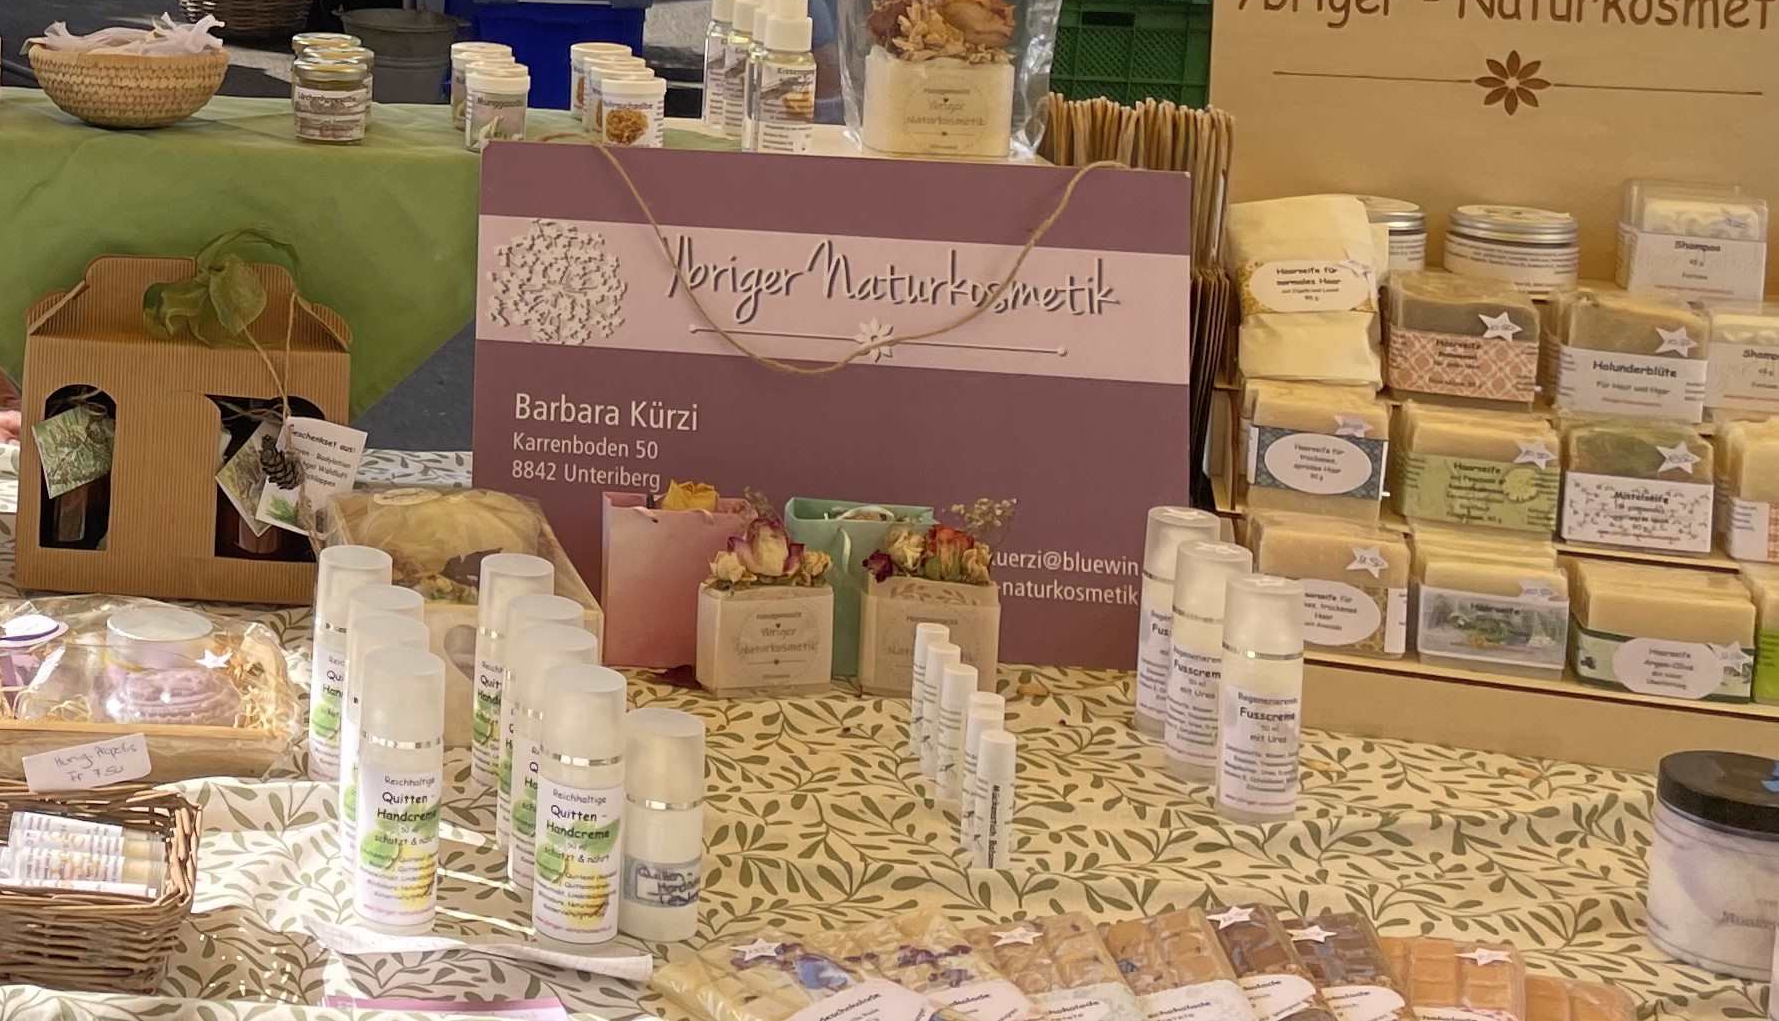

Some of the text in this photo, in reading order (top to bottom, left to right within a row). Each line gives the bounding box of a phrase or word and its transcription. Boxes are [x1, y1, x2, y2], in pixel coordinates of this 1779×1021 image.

[1675, 240, 1721, 252] Shampoo
[661, 234, 1120, 324] Ybriger Naturkosmetik
[1592, 360, 1678, 379] Holunderblüte
[515, 393, 698, 431] Barbara Kürzi
[512, 432, 659, 460] Karrenboden 50
[512, 459, 661, 493] 8842 Unteriberg
[1454, 461, 1501, 474] Haarseife
[1614, 491, 1669, 505] Mistelseife
[991, 550, 1139, 577] uerzi@bluewin
[1239, 705, 1296, 723] Fusscreme
[382, 791, 428, 804] Quitten
[552, 789, 608, 804] Reichhaltige
[376, 807, 438, 822] Handcreme
[550, 804, 598, 822] Quitten
[545, 820, 611, 841] Handcreme
[587, 853, 610, 865] nährt
